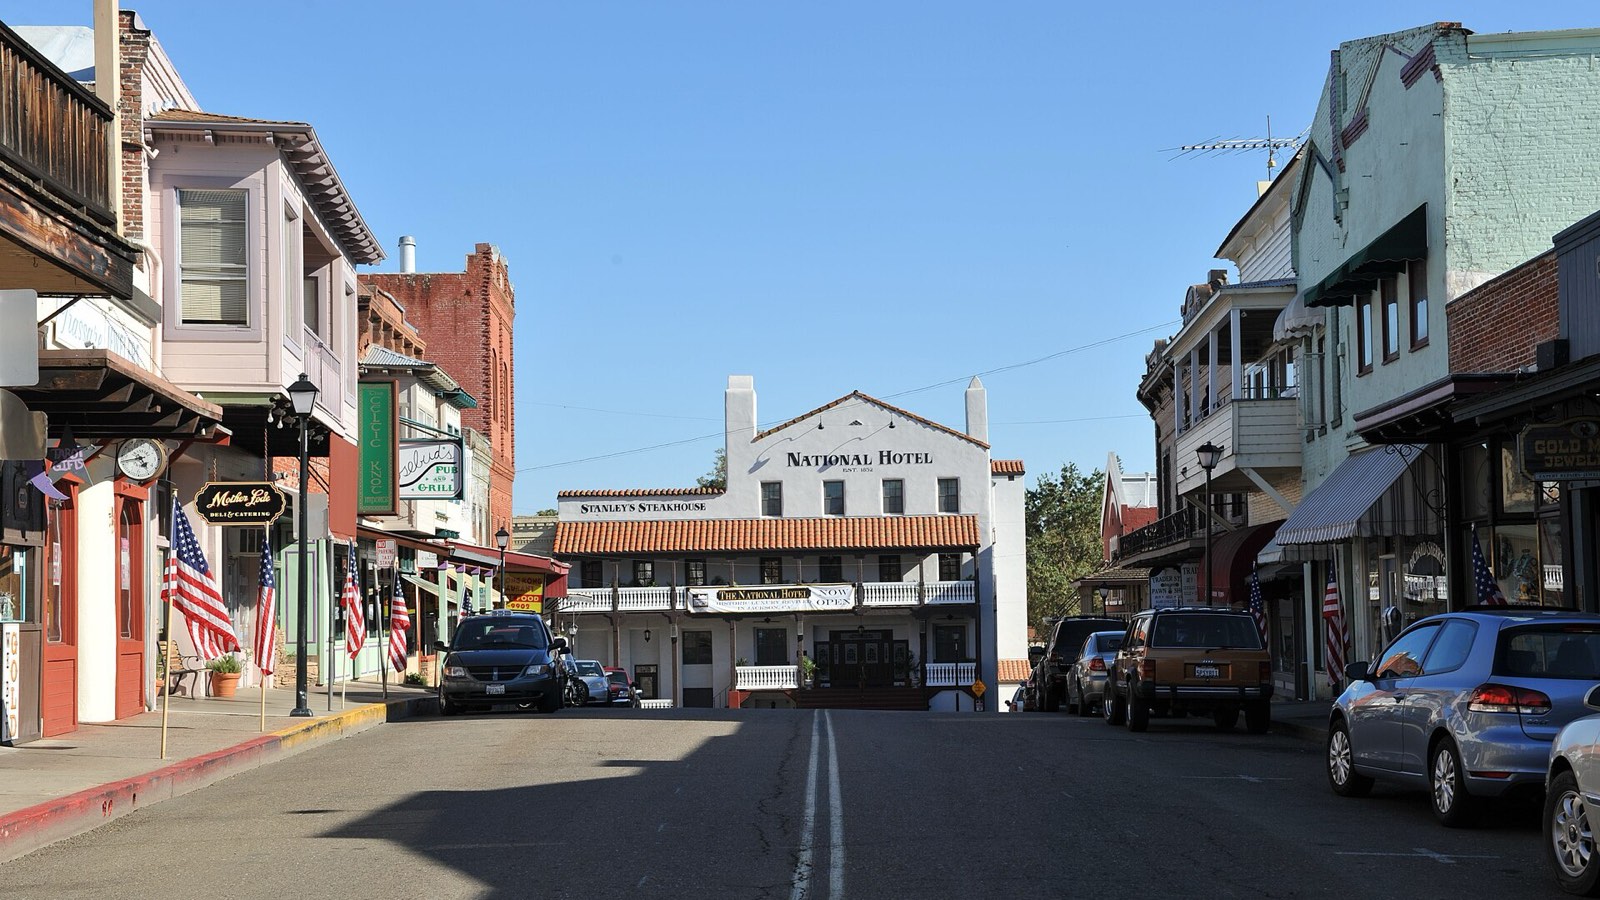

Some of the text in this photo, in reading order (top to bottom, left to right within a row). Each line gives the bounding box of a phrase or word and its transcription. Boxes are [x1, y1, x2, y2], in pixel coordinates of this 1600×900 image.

[1534, 439, 1581, 454] GOLD
[52, 458, 84, 471] GIFTS
[399, 444, 454, 477] sebud's
[786, 450, 933, 467] NATIONAL HOTEL
[435, 465, 458, 474] PUB
[417, 483, 455, 492] GRILL
[206, 489, 271, 509] Mother Lode
[580, 502, 706, 514] STANLEY'S STEAKHOUSE
[719, 589, 809, 600] THE NATIONAL HOTEL
[819, 588, 848, 596] NOW
[816, 598, 851, 606] OPEN
